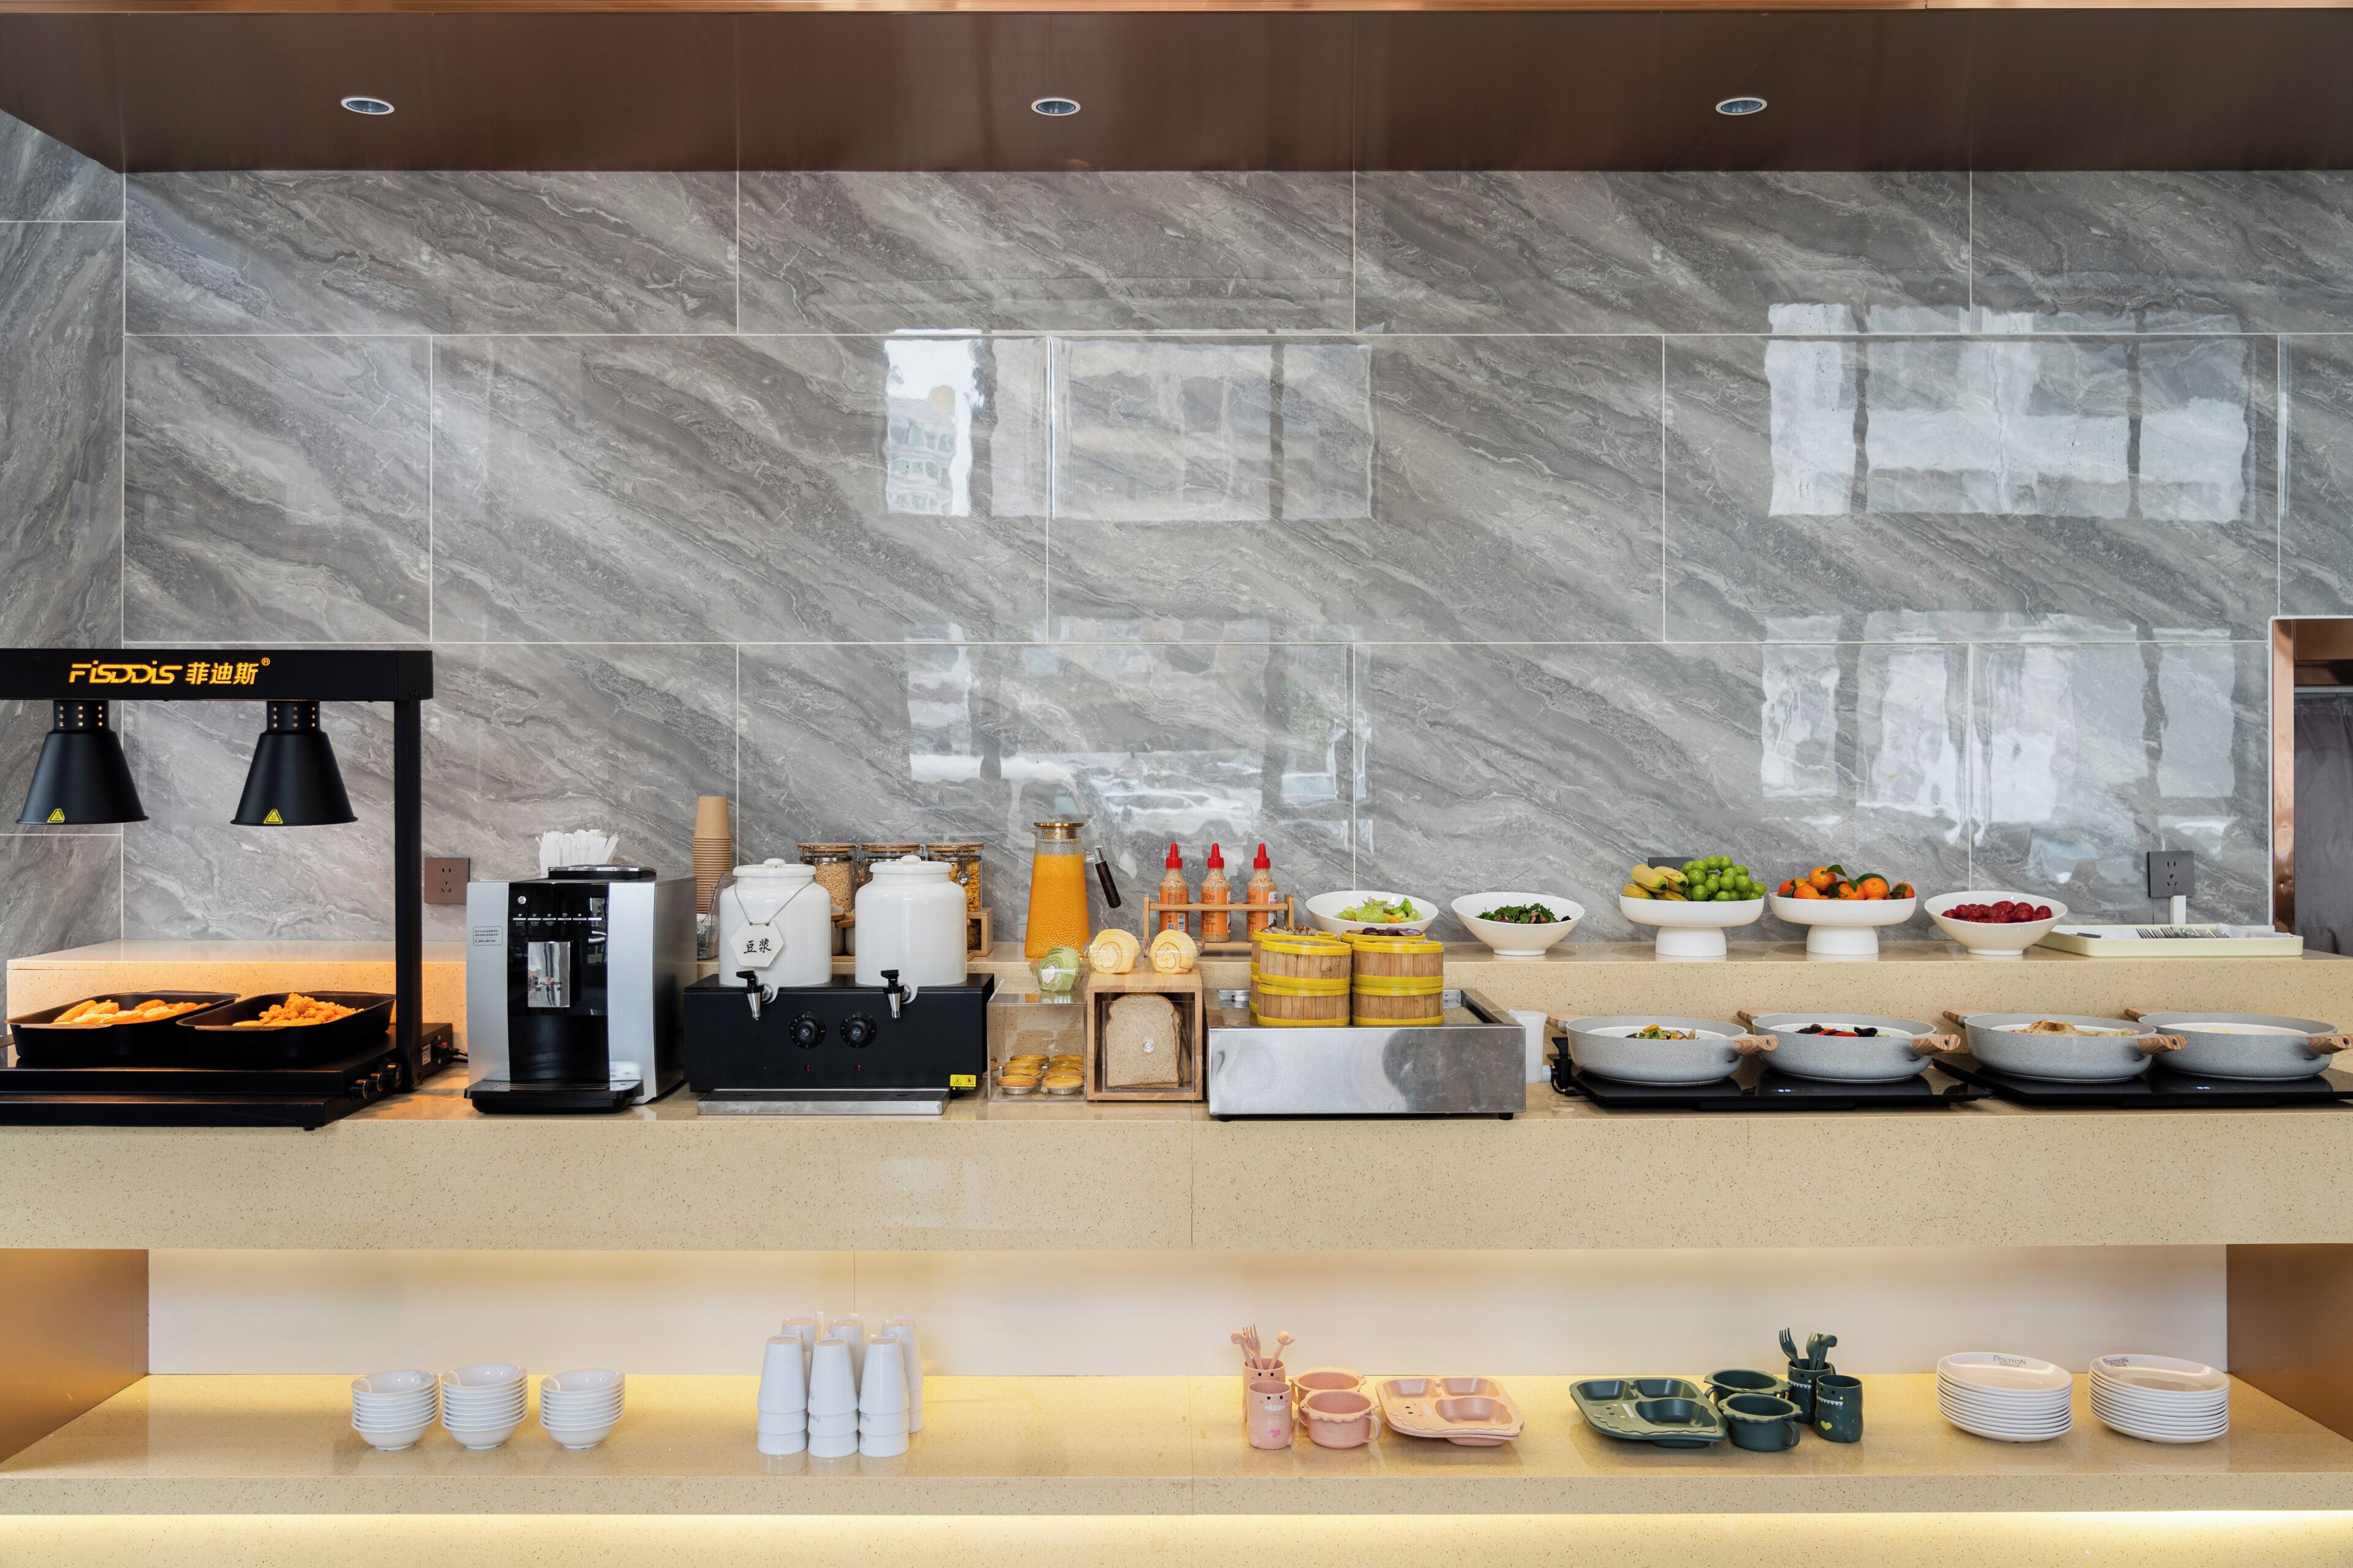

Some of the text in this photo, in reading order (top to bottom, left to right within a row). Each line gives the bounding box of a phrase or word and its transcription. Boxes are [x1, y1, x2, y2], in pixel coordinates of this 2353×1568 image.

[185, 662, 259, 685] 菲迪斯
[743, 938, 772, 954] 豆浆
